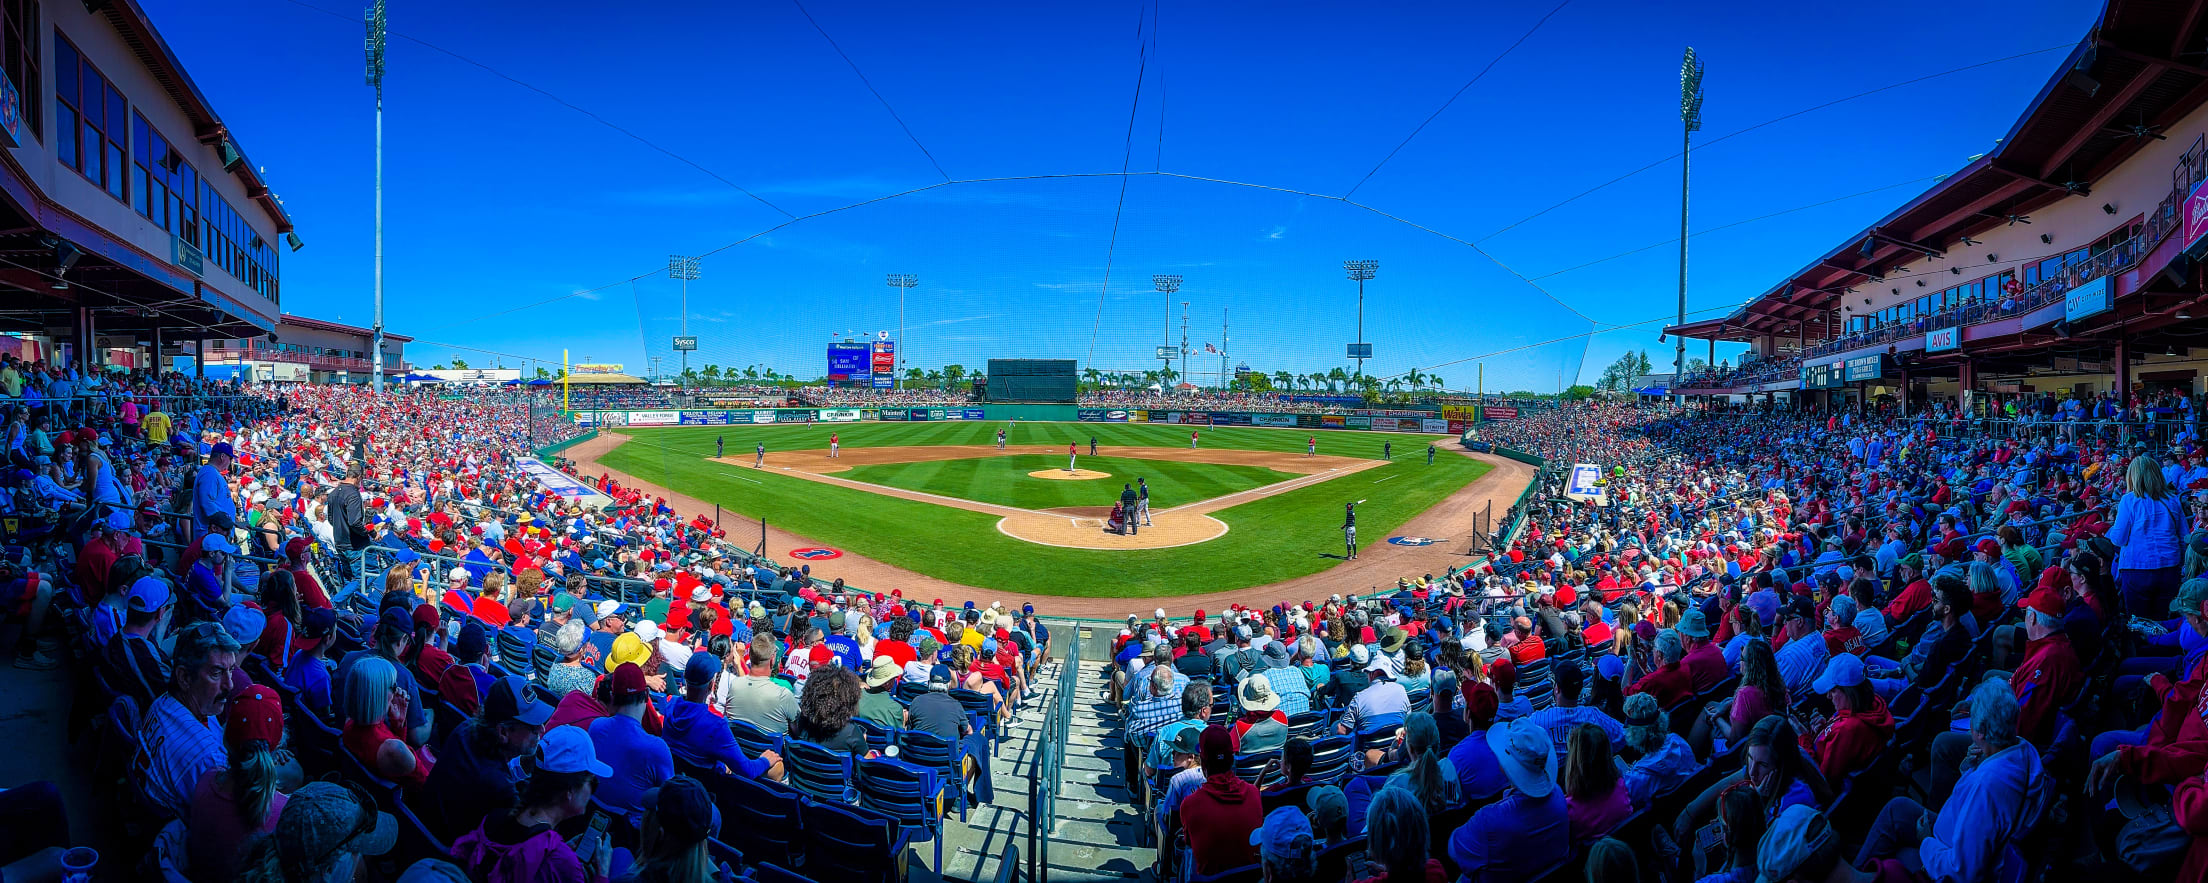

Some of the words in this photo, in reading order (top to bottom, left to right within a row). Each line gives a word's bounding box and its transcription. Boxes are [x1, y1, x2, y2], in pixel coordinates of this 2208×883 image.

[674, 337, 695, 346] Sysco
[1932, 331, 1951, 348] AVIS
[790, 656, 809, 669] UTLEY
